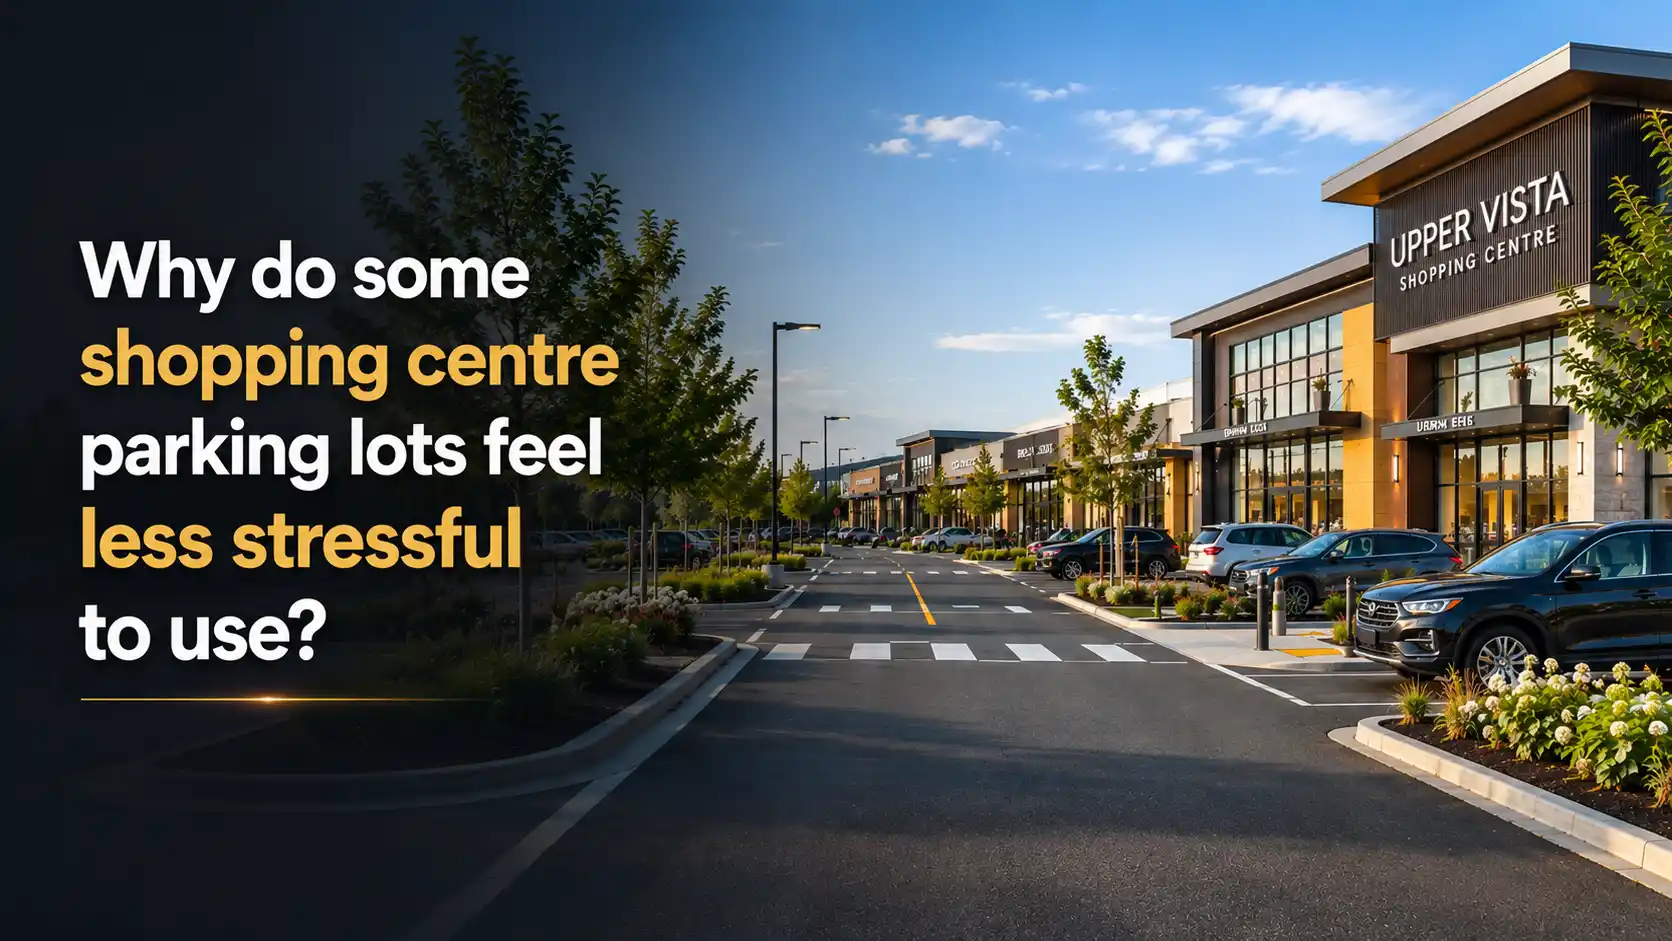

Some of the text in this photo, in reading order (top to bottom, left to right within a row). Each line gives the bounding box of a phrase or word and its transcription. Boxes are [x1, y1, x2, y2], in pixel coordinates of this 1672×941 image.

[1391, 170, 1571, 268] UPPER VISTA
[1400, 224, 1557, 292] SHOPPING CENTRE
